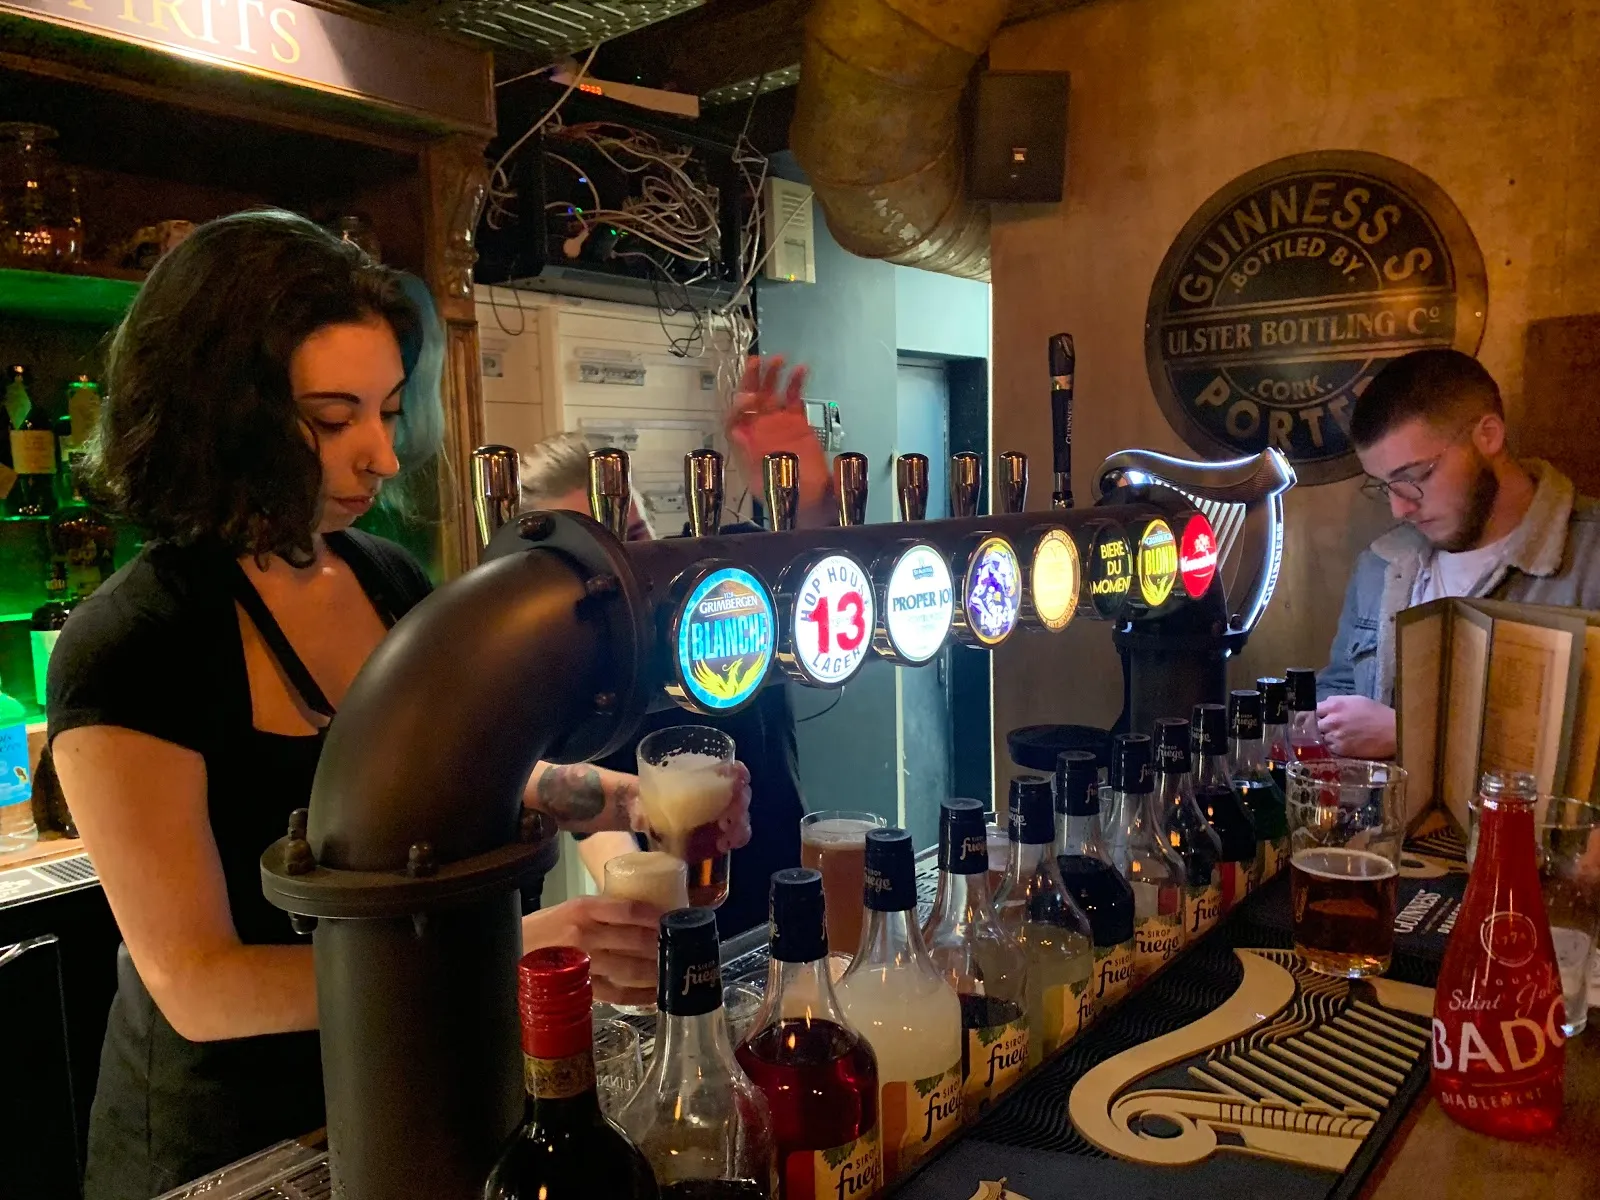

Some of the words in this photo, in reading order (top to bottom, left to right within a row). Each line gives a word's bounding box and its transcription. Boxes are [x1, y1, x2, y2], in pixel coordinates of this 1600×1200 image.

[42, 0, 301, 64] RITS
[1229, 236, 1327, 289] BOTTLED
[1328, 246, 1365, 275] BY
[1167, 322, 1252, 356] ULSTER
[1260, 309, 1396, 346] BOTTLING
[1257, 375, 1325, 400] CORK
[1194, 374, 1374, 453] PORTE
[1107, 559, 1122, 576] DU
[699, 595, 759, 614] GRIMBERGEN
[800, 577, 821, 622] HOP
[892, 591, 937, 612] PROPER
[691, 612, 767, 661] BLANCHE
[808, 590, 866, 654] 13
[1155, 744, 1185, 762] fuego
[959, 836, 987, 861] fueg
[864, 873, 893, 893] uego
[1134, 930, 1181, 961] fuego
[1147, 929, 1171, 939] SIROP
[1096, 960, 1135, 998] fueg
[1449, 988, 1501, 1012] Saint
[984, 1043, 1029, 1087] fueg
[921, 1091, 964, 1143] fueg
[856, 1144, 876, 1170] SIRO
[834, 1162, 880, 1200] fueg
